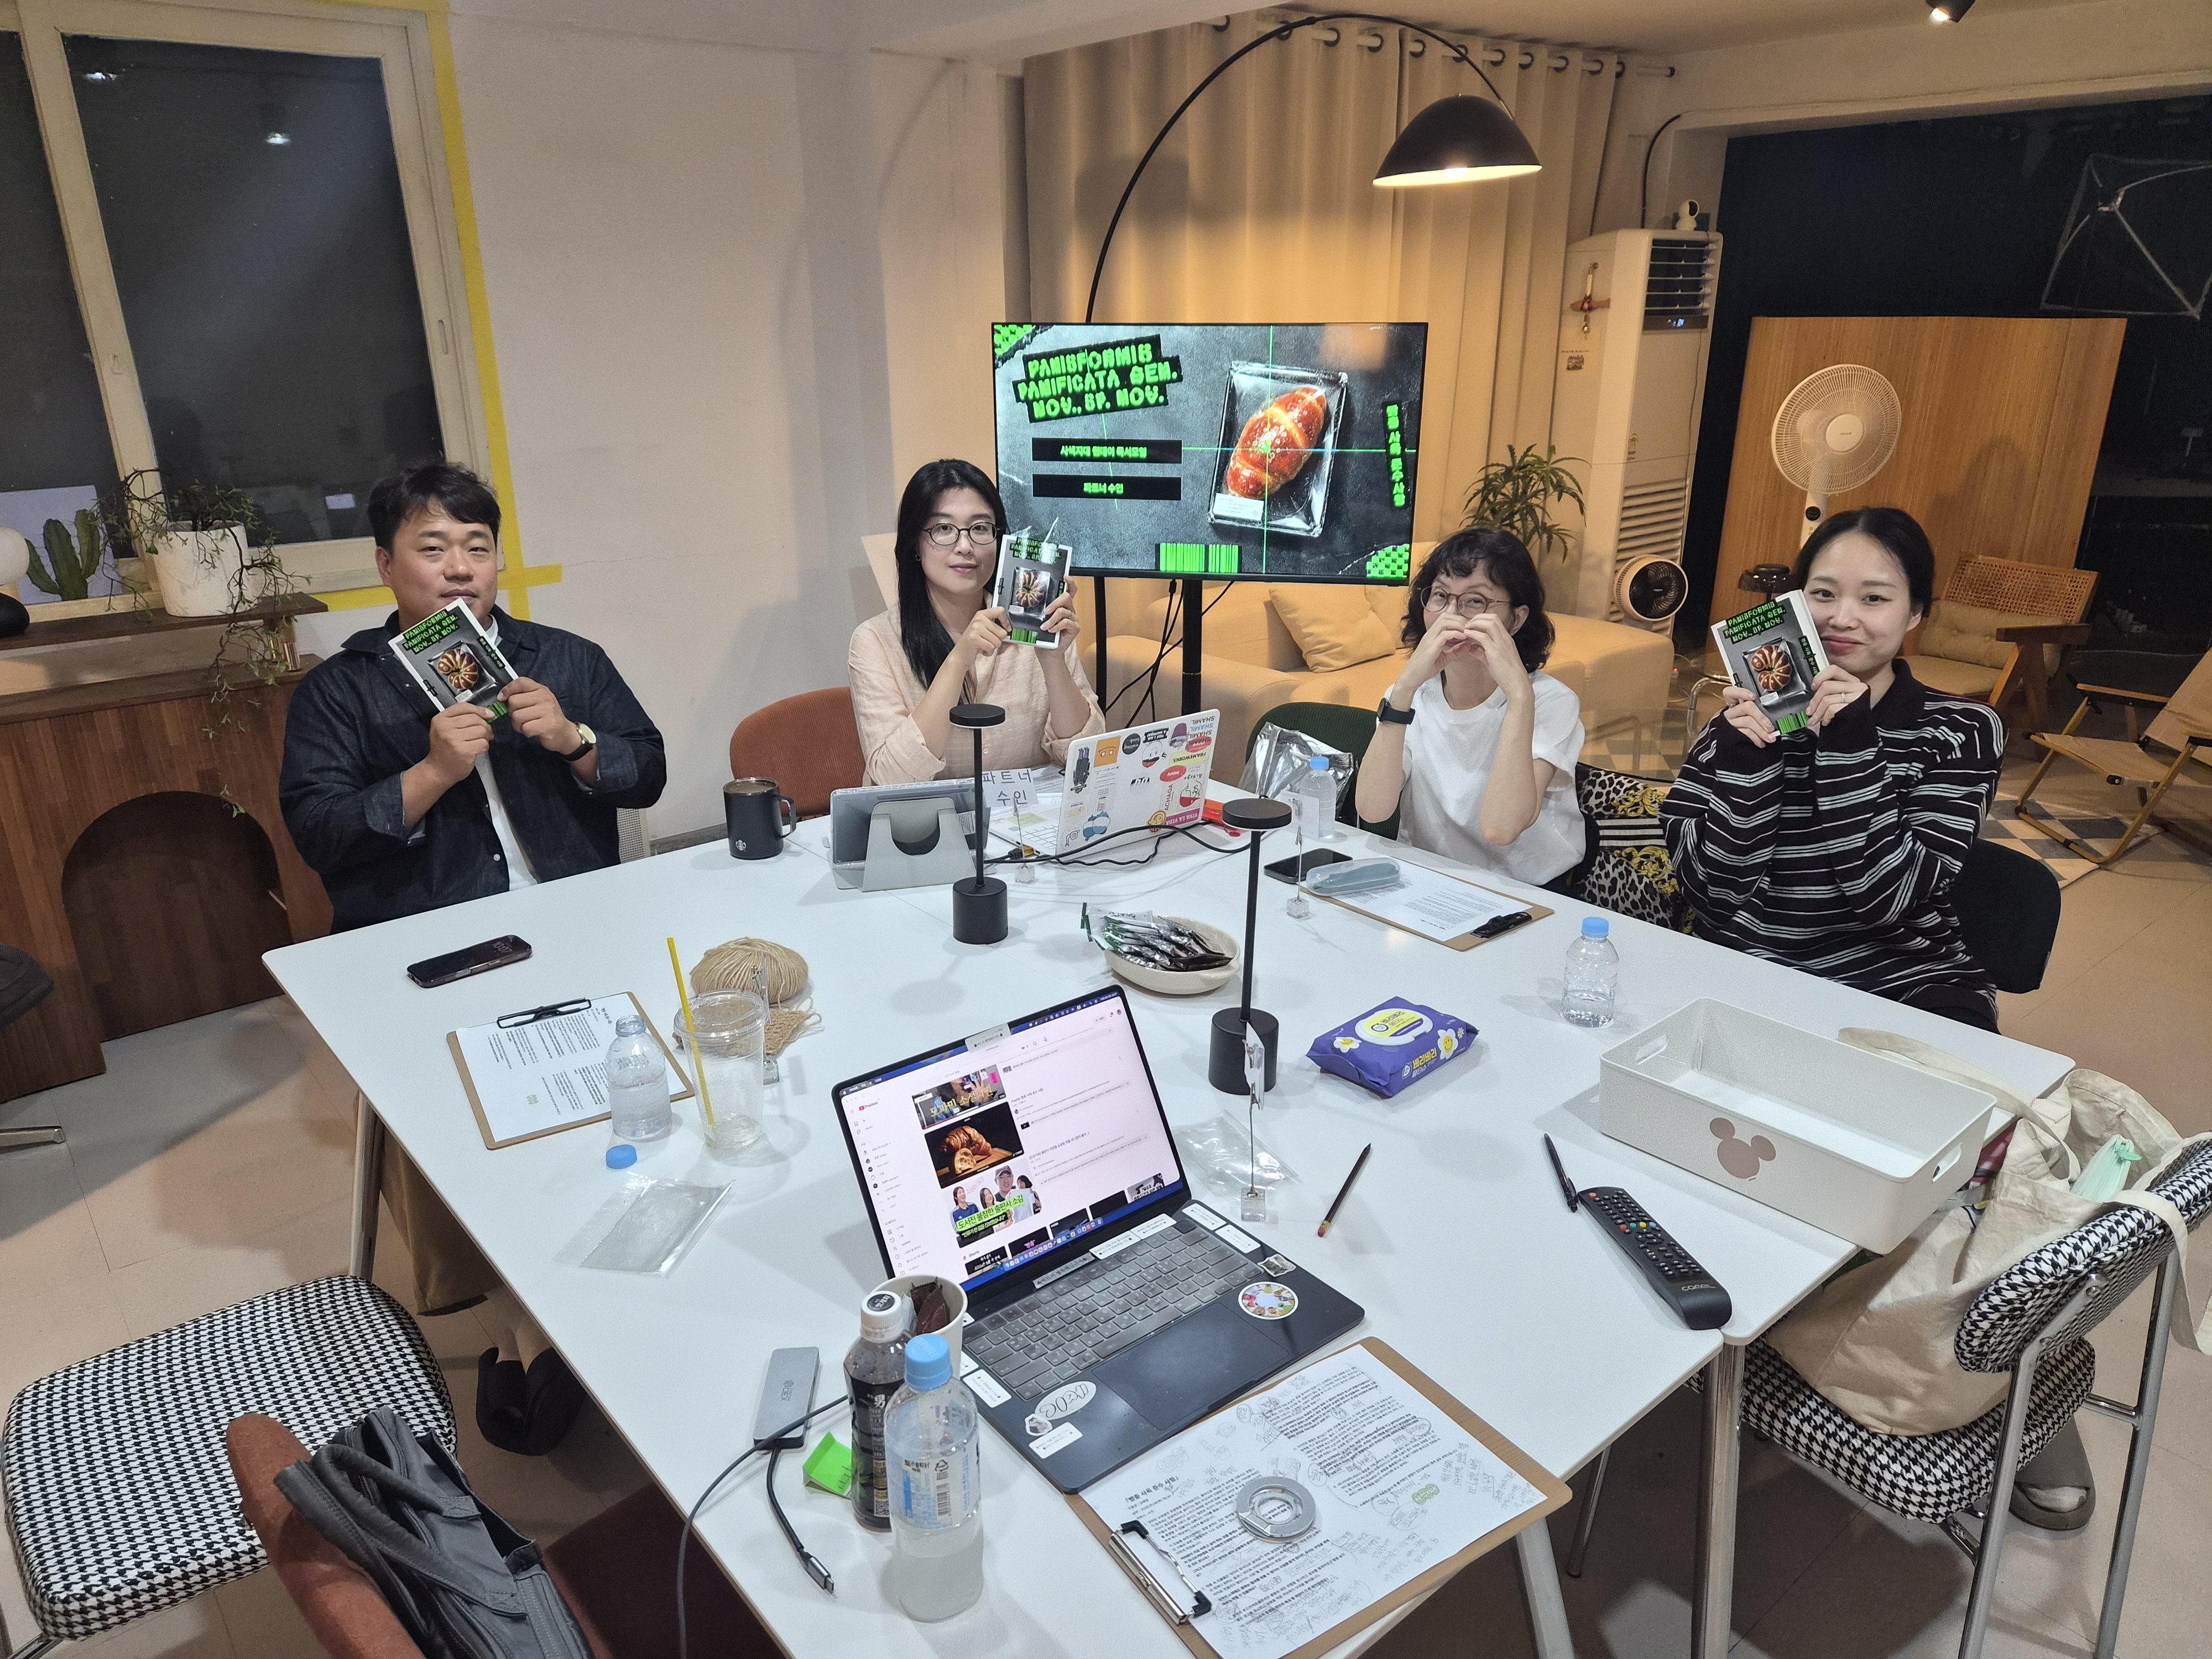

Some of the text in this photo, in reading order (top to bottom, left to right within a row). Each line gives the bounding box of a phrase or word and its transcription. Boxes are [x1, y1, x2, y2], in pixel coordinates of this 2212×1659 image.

[1028, 343, 1152, 378] PANISFORMIS
[1018, 369, 1120, 400] PANIFICATA
[1116, 385, 1164, 406] NOV.
[1083, 482, 1124, 494] 파트너 수인
[1189, 722, 1213, 732] SHAMIL
[1190, 715, 1215, 726] SHAMIL
[1187, 728, 1212, 740] SHAMIL
[1172, 751, 1206, 763] FRAMEWORKS.
[983, 768, 1033, 784] 파트너
[997, 790, 1027, 806] 수인
[1164, 784, 1173, 811] ACHAGA
[1413, 1047, 1437, 1069] 베리베리
[928, 1098, 957, 1117] 도파민
[957, 1089, 978, 1107] 소설
[957, 1215, 977, 1229] 도서전
[975, 1207, 995, 1221] 불참한
[994, 1199, 1012, 1213] 출판사
[1011, 1194, 1024, 1205] 소감
[1151, 1481, 1165, 1491] 준수
